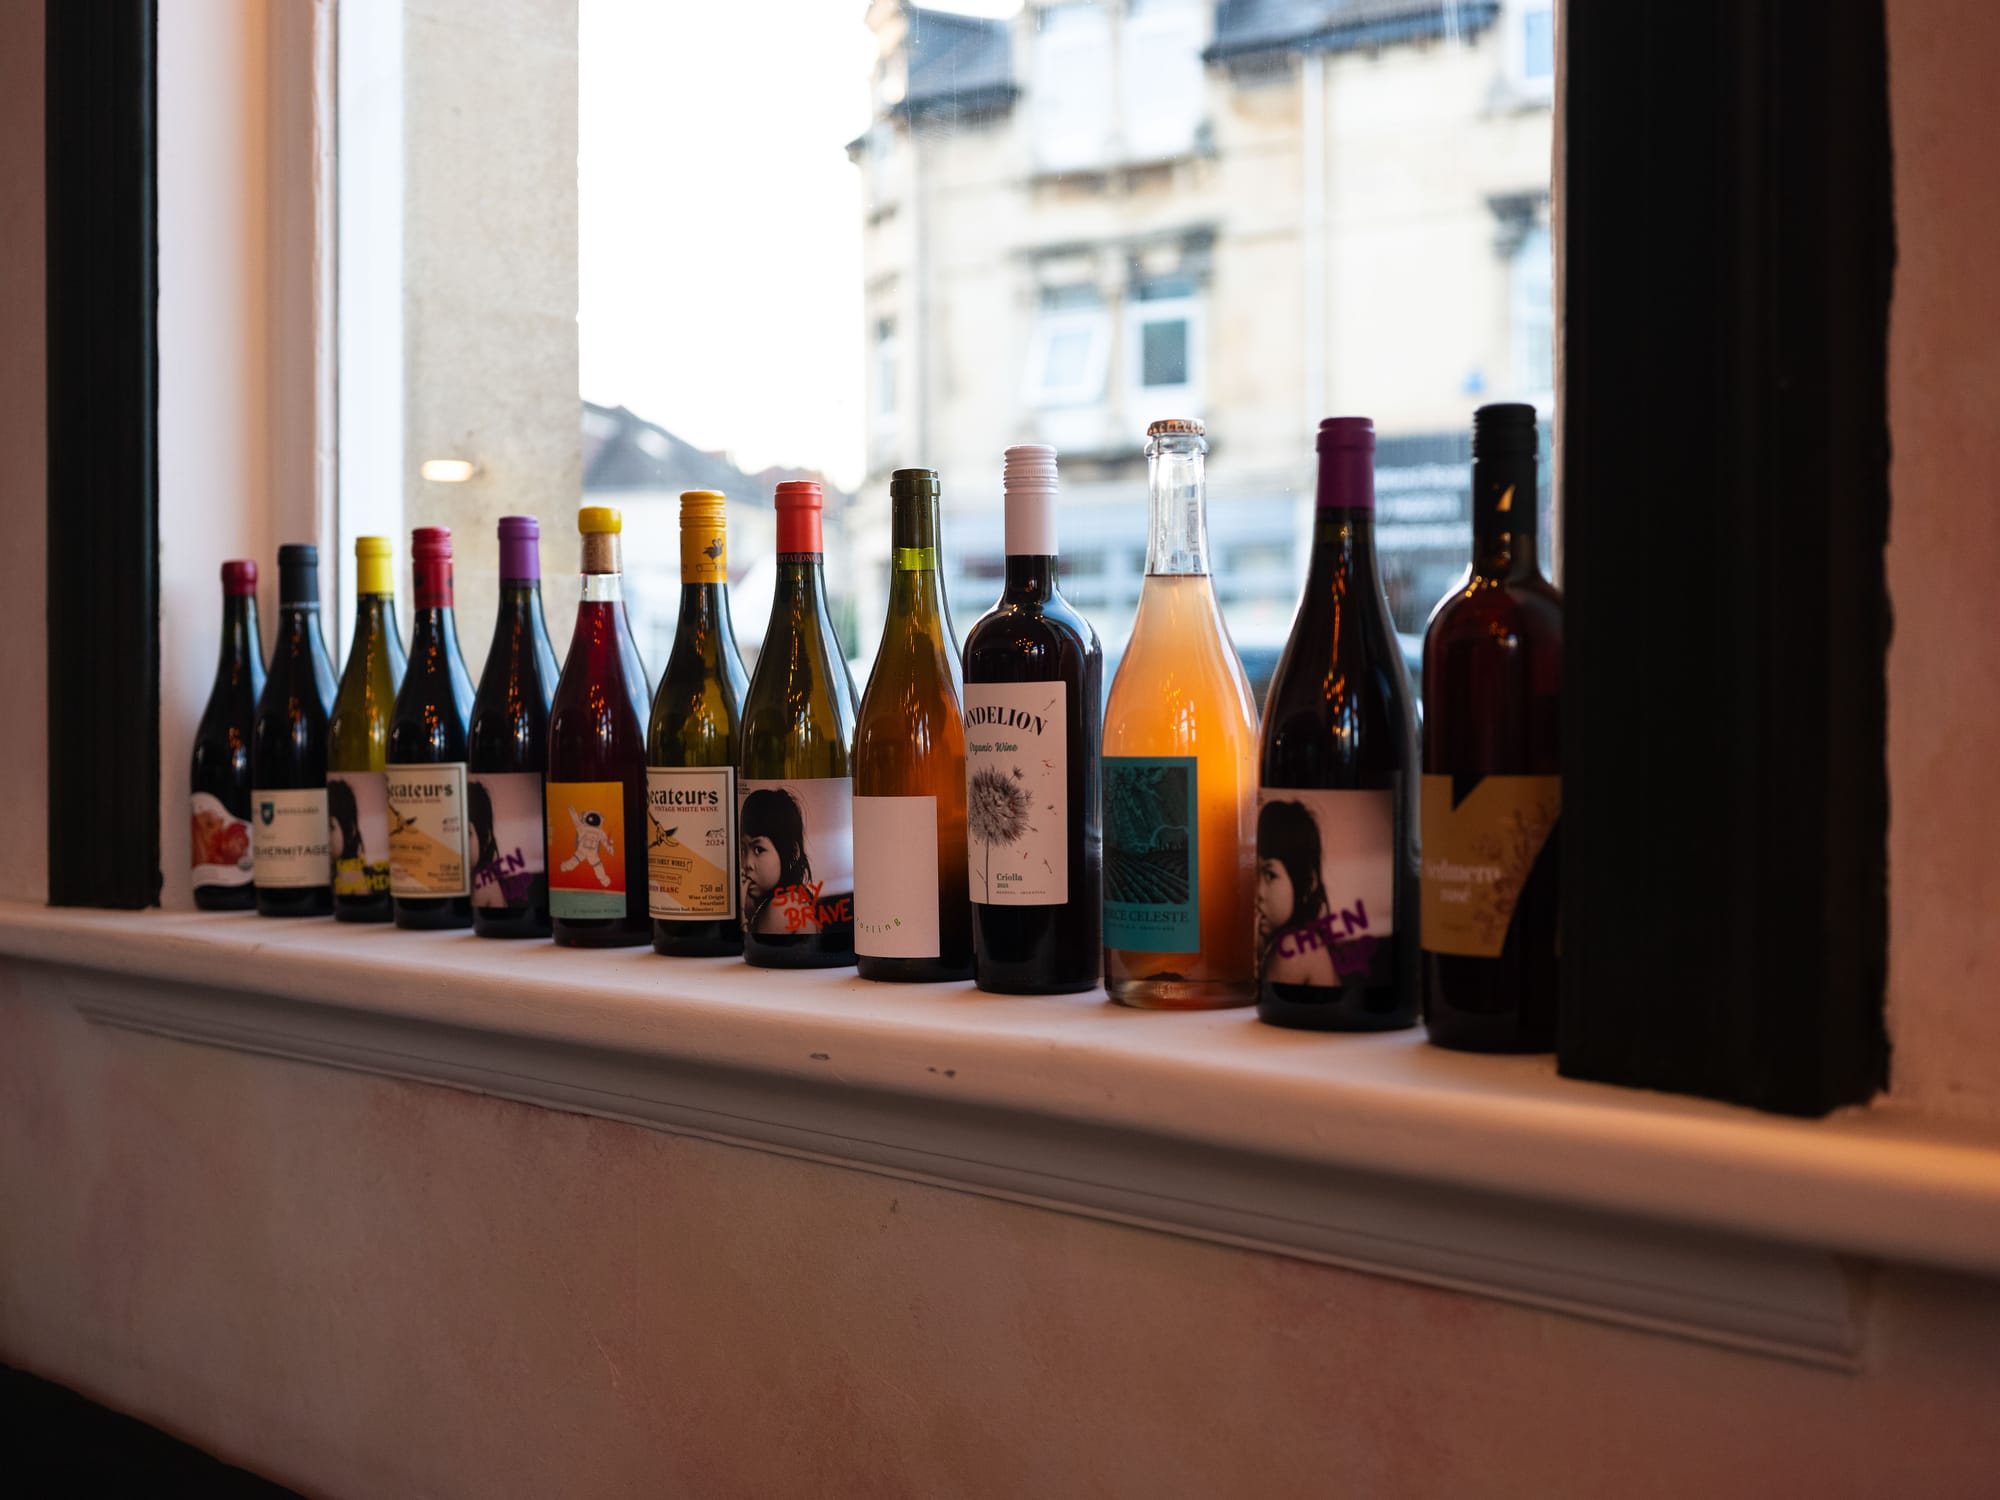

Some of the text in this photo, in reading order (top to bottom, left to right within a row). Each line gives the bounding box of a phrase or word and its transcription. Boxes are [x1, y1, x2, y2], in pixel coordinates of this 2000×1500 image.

[995, 742, 1018, 752] Wine
[996, 873, 1023, 881] Criolla
[660, 886, 680, 894] BLANC
[700, 883, 724, 893] 750 ml
[771, 880, 825, 908] STAY
[783, 898, 854, 932] BRAVE
[1128, 910, 1188, 923] CELESTE
